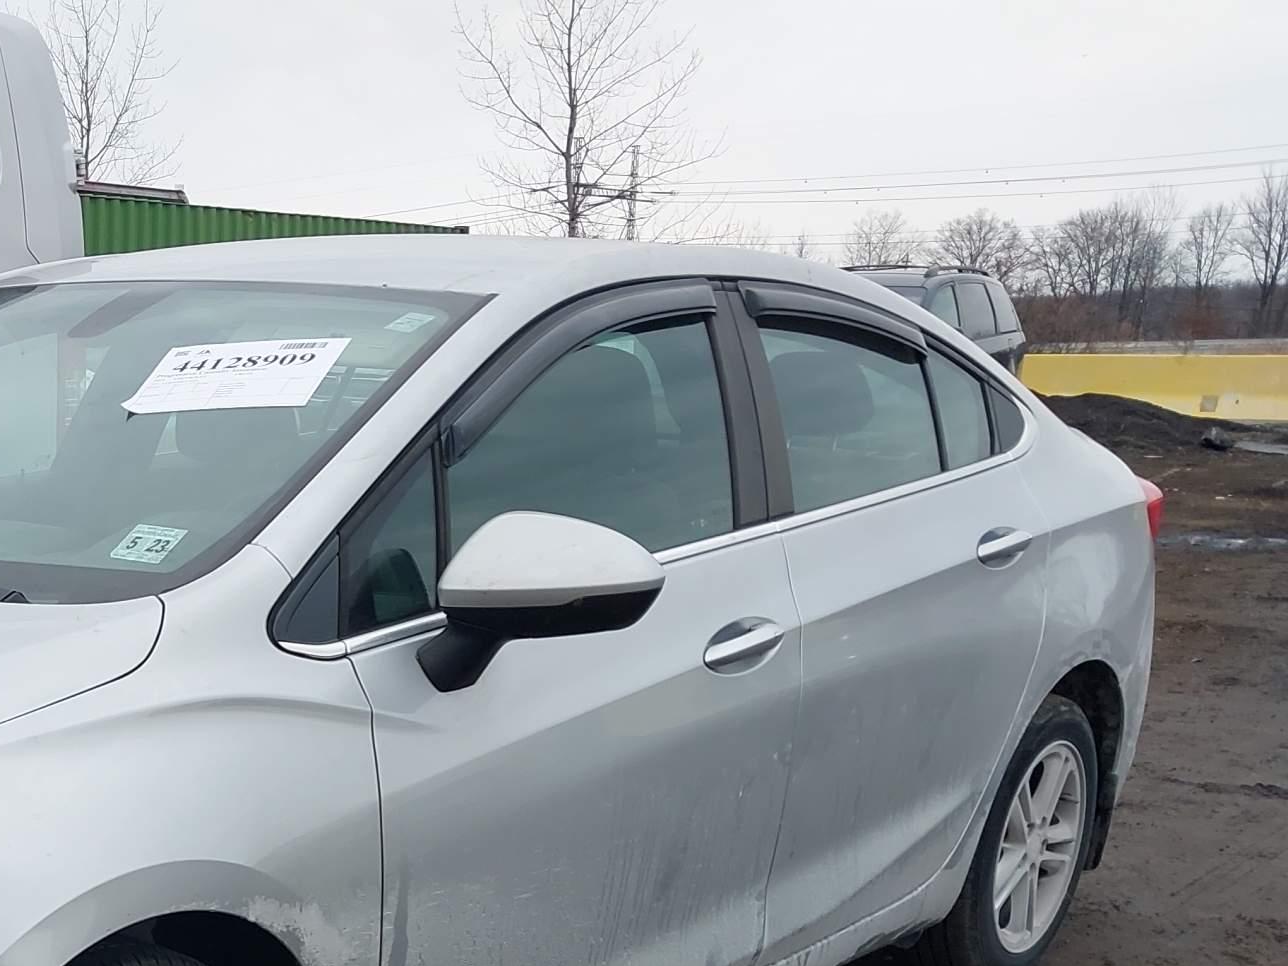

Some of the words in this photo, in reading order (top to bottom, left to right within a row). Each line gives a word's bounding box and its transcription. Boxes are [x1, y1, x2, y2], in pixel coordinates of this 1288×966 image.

[172, 353, 316, 372] 44128909
[126, 536, 143, 550] 5
[144, 538, 171, 553] 23
